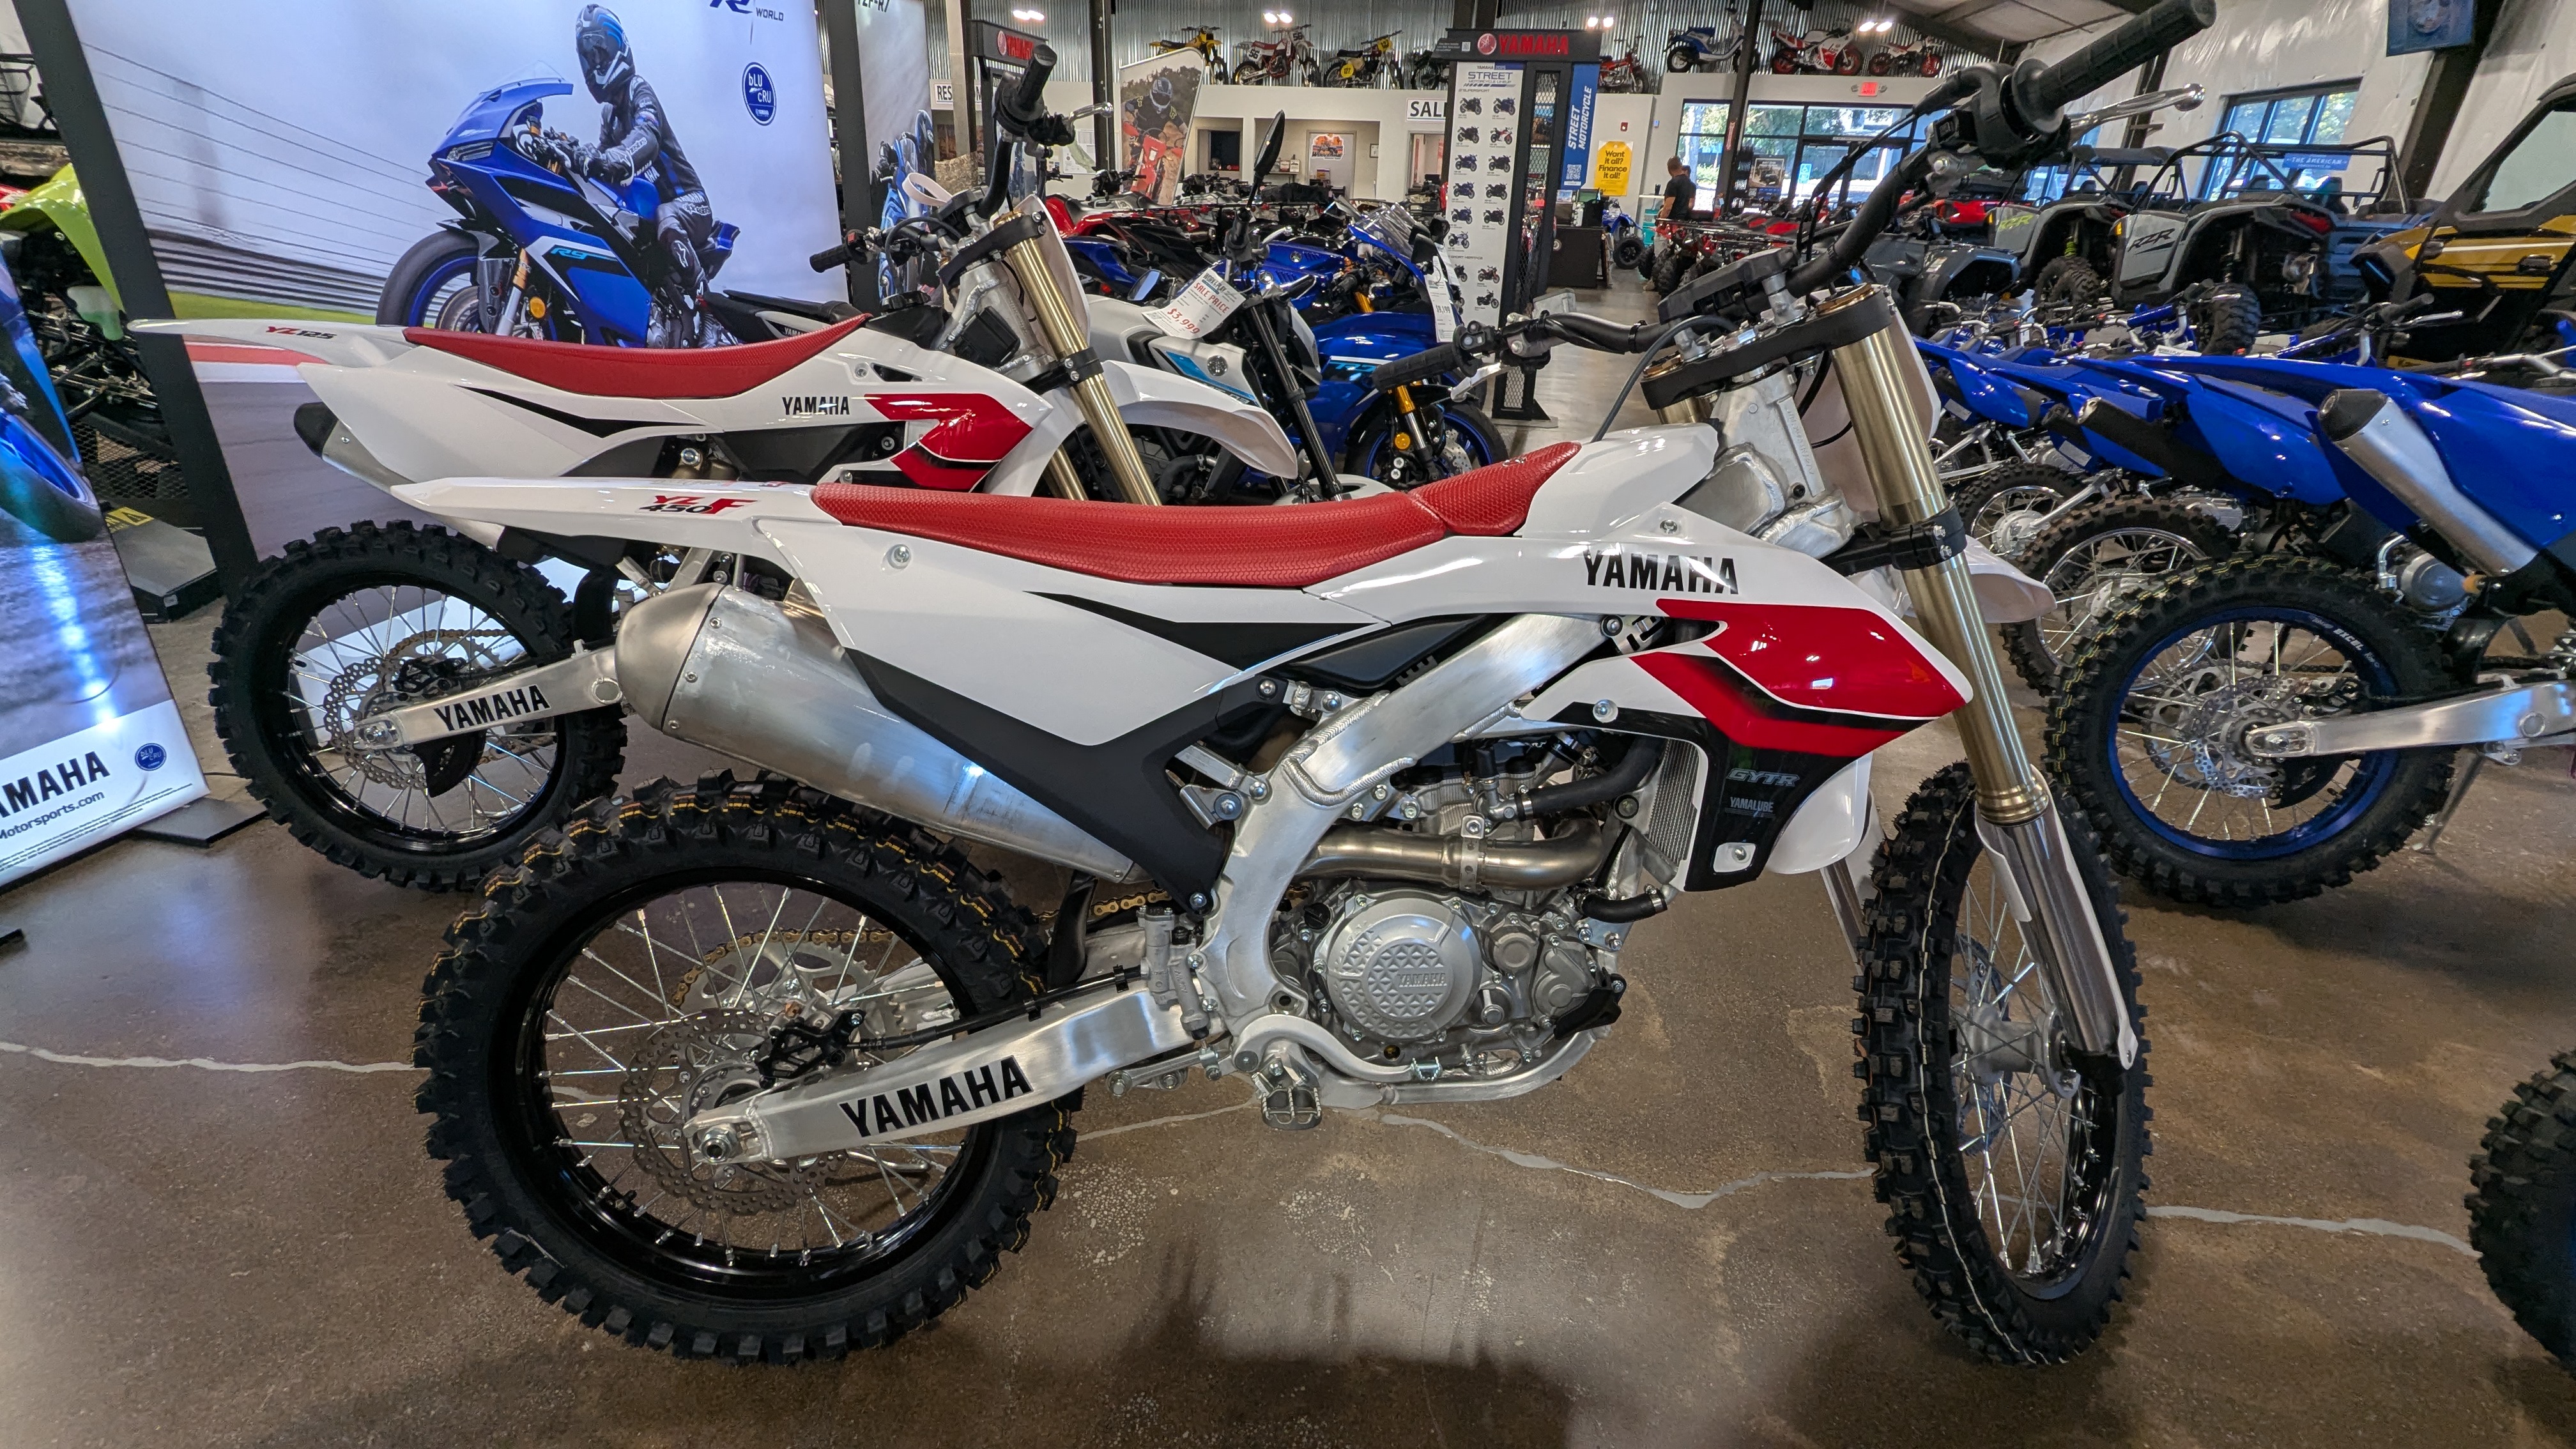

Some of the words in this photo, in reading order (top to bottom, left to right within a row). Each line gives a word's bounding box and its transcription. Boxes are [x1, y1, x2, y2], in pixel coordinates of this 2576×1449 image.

[756, 7, 784, 21] WORLD
[1499, 34, 1569, 55] YAMAHA
[1468, 72, 1514, 80] STREET
[1567, 105, 1581, 150] STREET
[1578, 86, 1592, 150] MOTORCYCLE
[2128, 228, 2175, 253] RZR
[550, 247, 588, 259] R9
[1193, 282, 1209, 298] SALE
[1209, 295, 1230, 314] PRICE
[784, 326, 804, 335] YAMA
[1167, 308, 1200, 334] $3,999
[266, 326, 337, 339] YZ125
[781, 396, 850, 416] YAMAHA
[652, 495, 706, 505] YZ
[1582, 549, 1739, 595] YAMAHA
[433, 685, 551, 732] YAMAHA
[0, 750, 111, 818] MAHA
[1726, 767, 1800, 787] GYTR
[1729, 796, 1774, 813] YAMALUBE
[1397, 972, 1448, 988] YAMAHA
[838, 1056, 1034, 1138] YAMAHA
